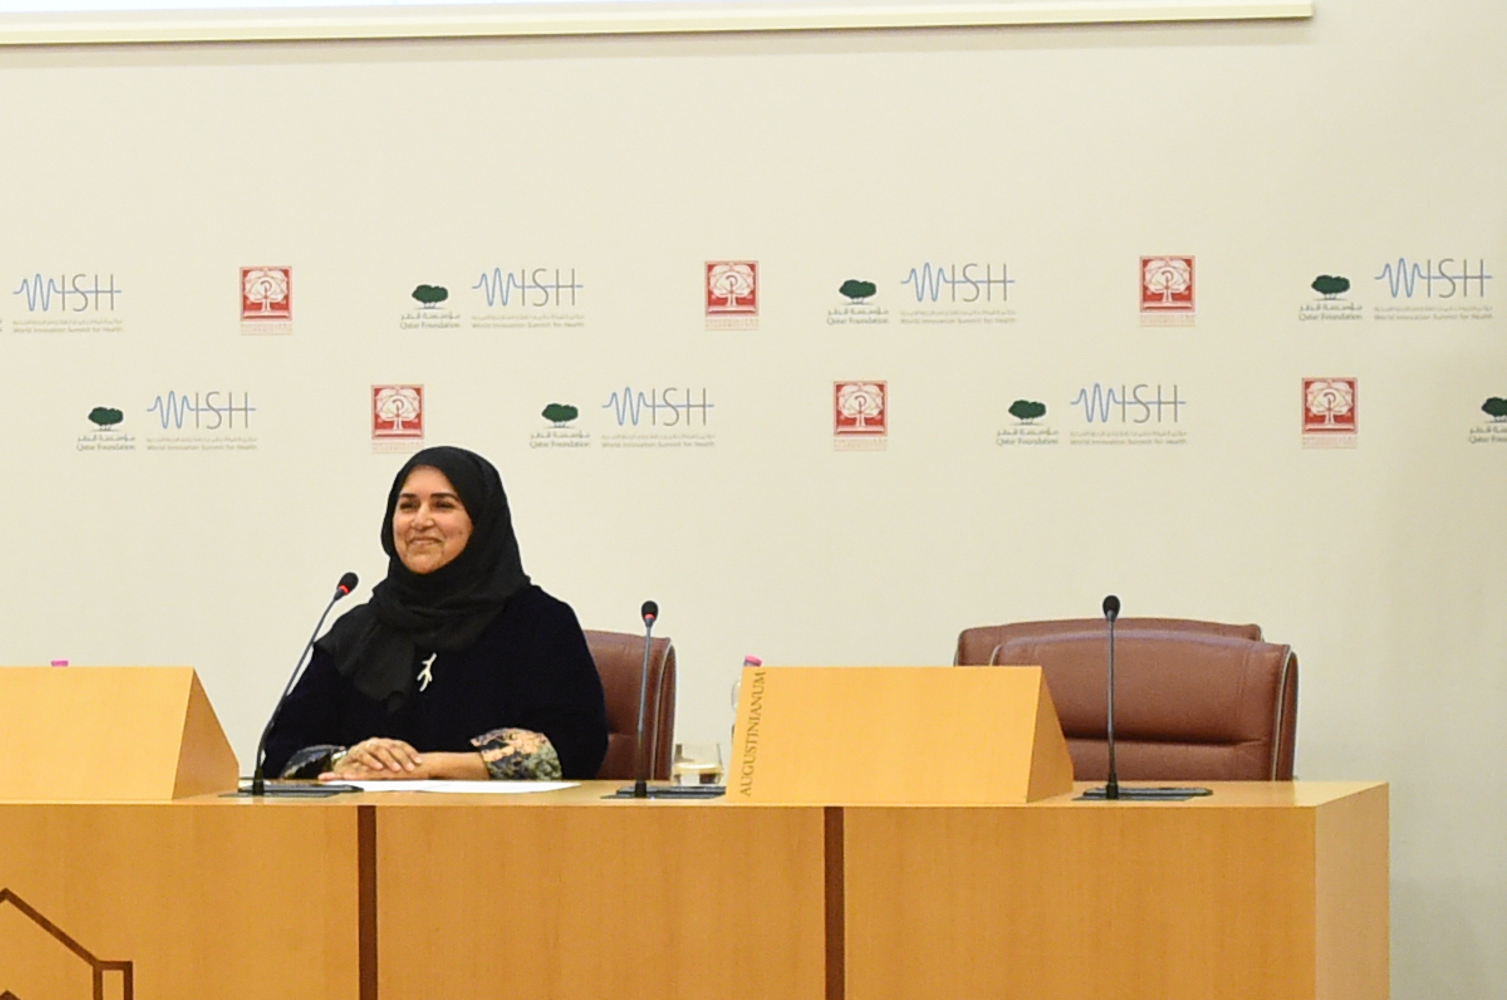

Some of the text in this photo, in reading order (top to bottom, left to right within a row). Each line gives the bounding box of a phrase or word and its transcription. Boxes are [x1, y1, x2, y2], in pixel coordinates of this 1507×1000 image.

[13, 273, 122, 312] WISH
[472, 267, 583, 307] WISH
[901, 262, 1015, 302] WISH
[1374, 258, 1493, 298] WISH
[147, 390, 256, 430] WISH
[602, 387, 714, 426] WISH
[1071, 383, 1186, 423] WISH
[739, 671, 766, 797] AUGUSTINIANUM
